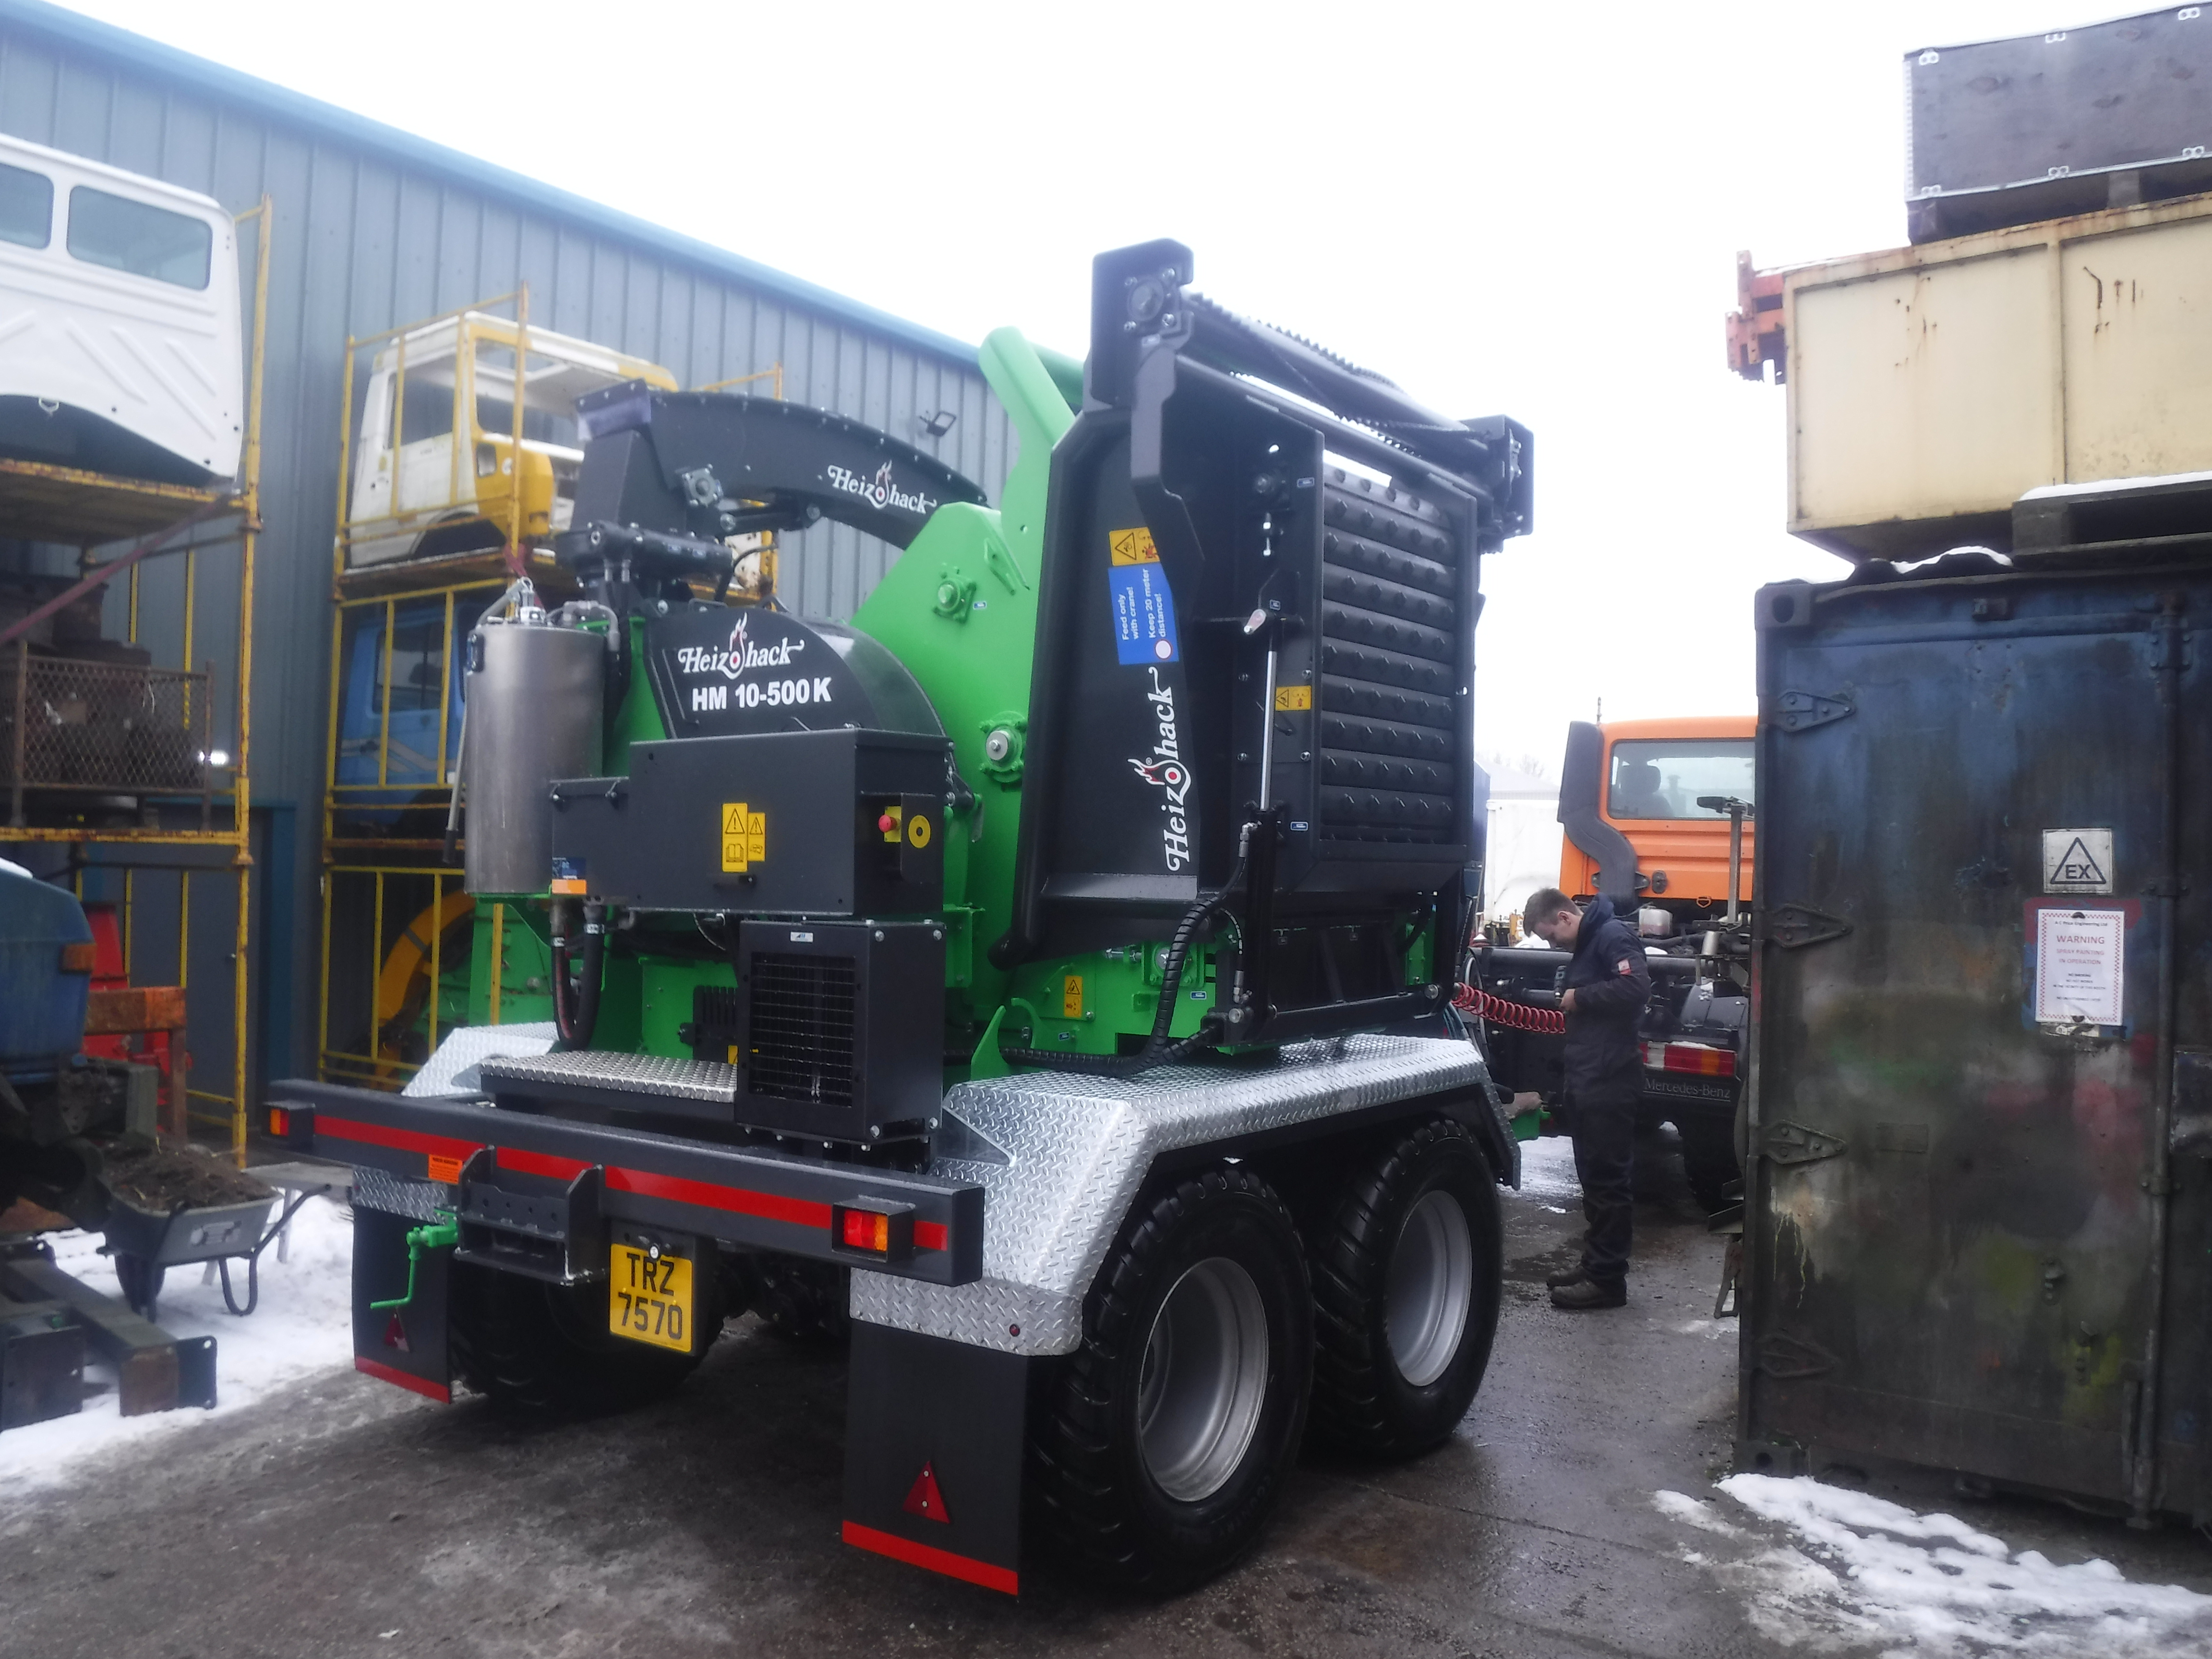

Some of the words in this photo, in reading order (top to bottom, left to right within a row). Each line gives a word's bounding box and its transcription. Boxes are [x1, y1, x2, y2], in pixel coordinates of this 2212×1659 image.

[1142, 568, 1151, 597] meter
[1118, 594, 1127, 614] only
[1126, 587, 1136, 617] crane!
[1145, 599, 1153, 611] 20
[1148, 613, 1156, 638] Keep
[1154, 593, 1166, 637] distance!
[1120, 616, 1129, 640] Feed
[1130, 619, 1139, 639] with
[692, 685, 727, 711] HM
[2065, 865, 2091, 879] EX
[2056, 936, 2105, 944] WARNING
[1644, 1078, 1731, 1098] Mercedes-Benz
[626, 1252, 674, 1296] TRZ
[618, 1292, 683, 1340] 7570
